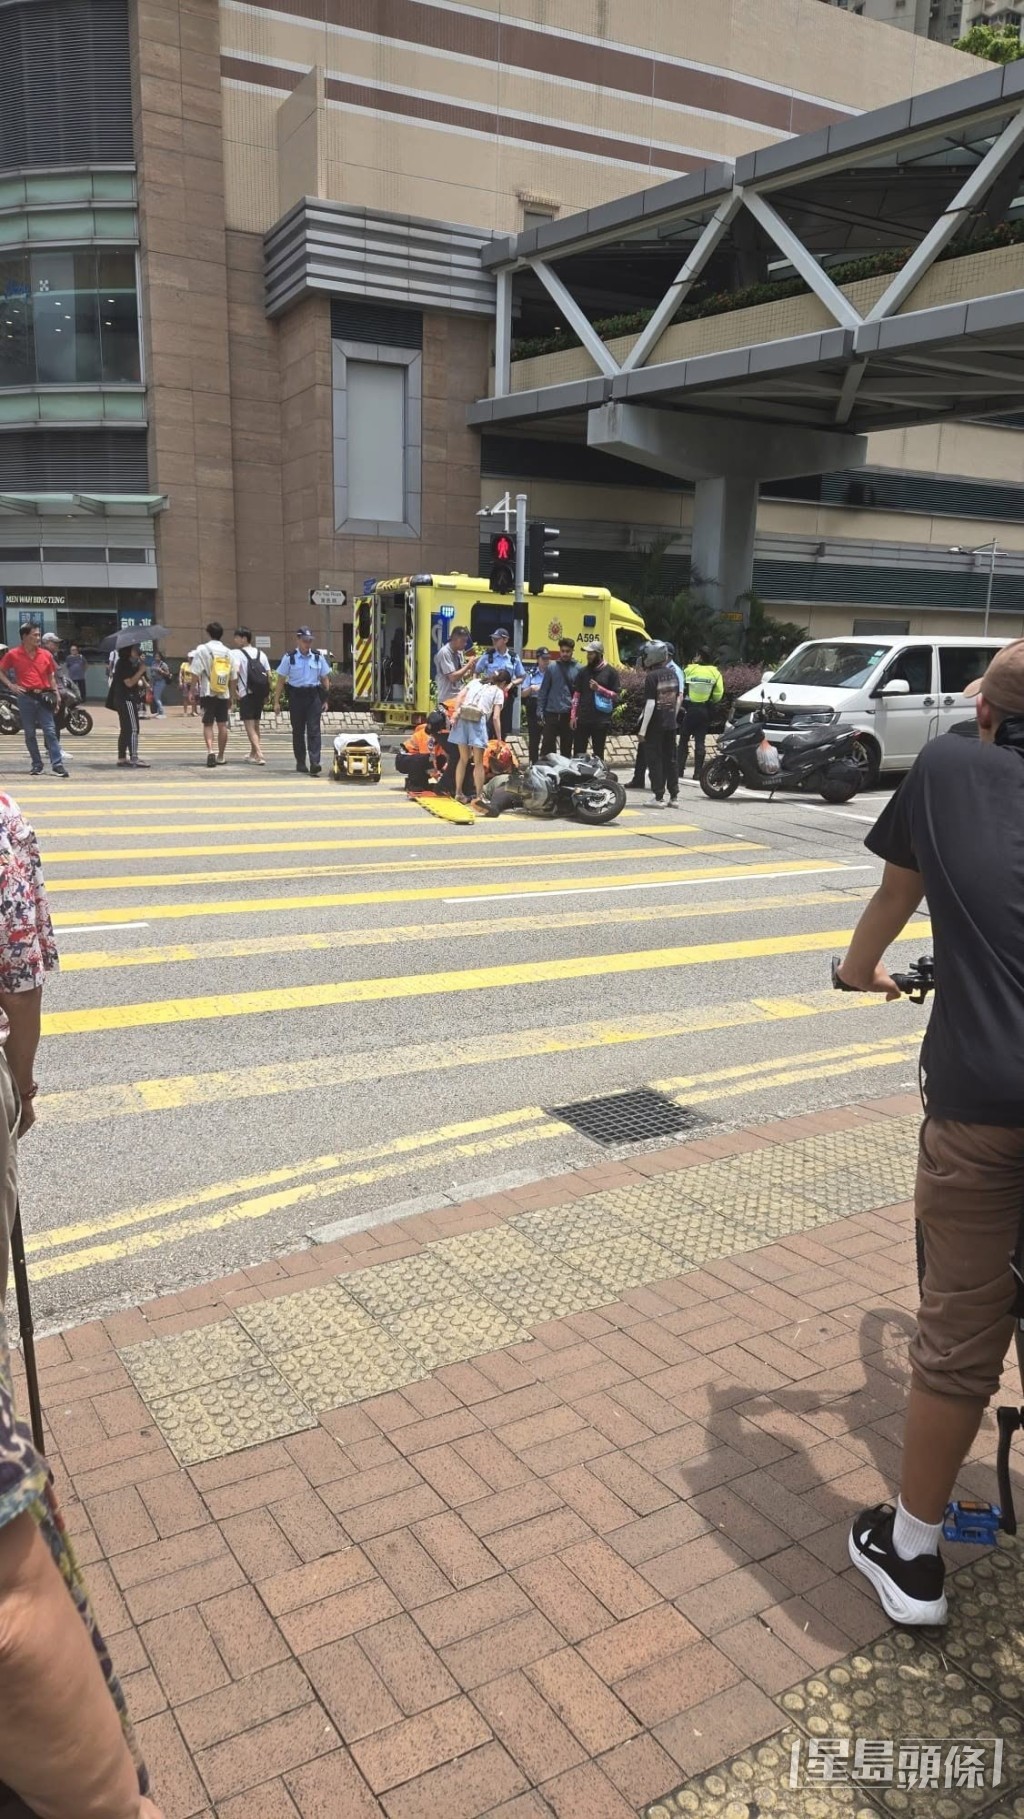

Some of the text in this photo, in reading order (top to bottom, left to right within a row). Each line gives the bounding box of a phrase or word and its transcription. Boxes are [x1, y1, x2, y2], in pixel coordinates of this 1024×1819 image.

[6, 595, 65, 604] MEN WAH BING TENG
[576, 632, 600, 643] A595
